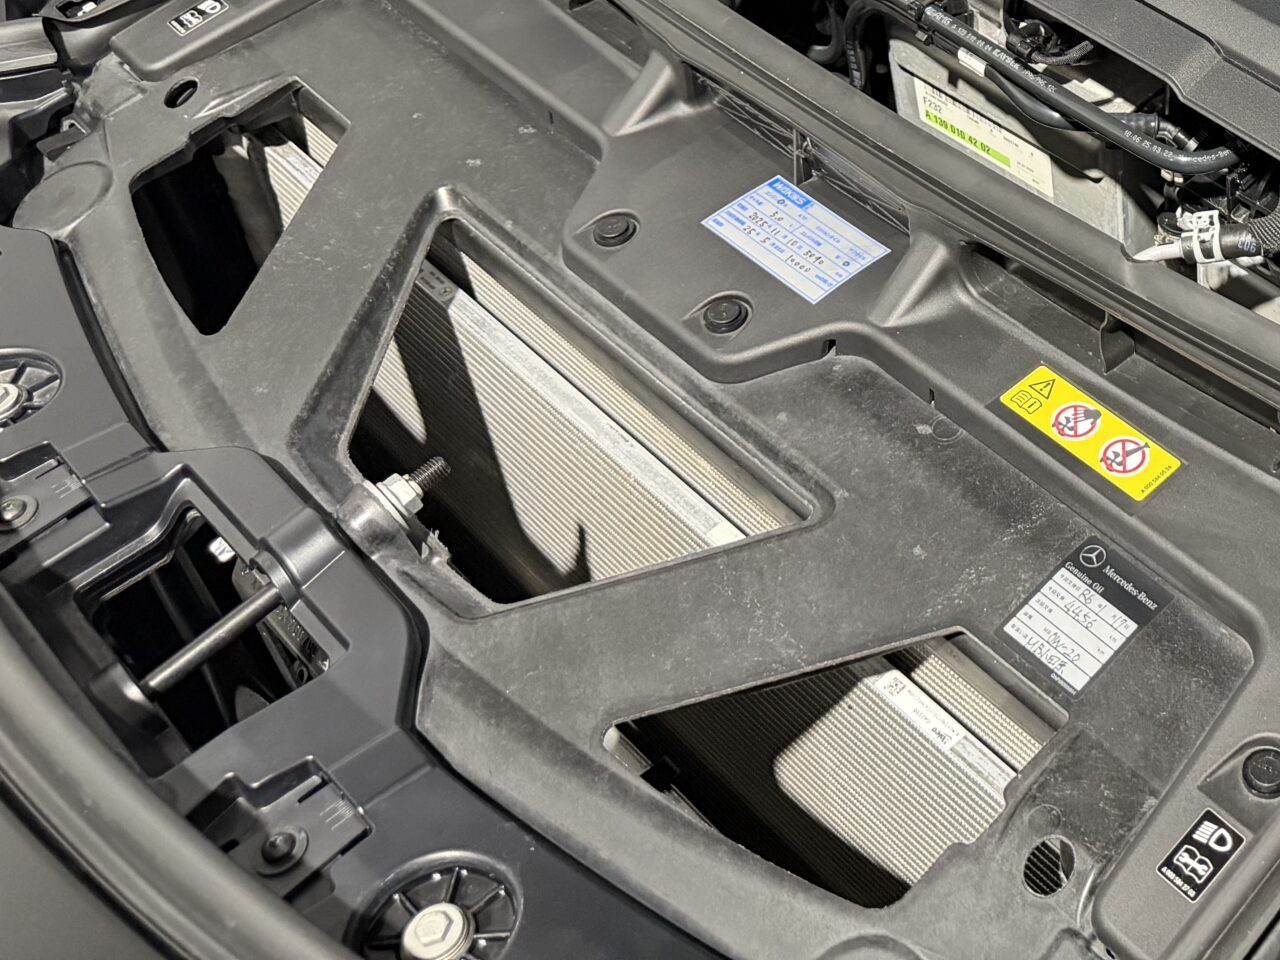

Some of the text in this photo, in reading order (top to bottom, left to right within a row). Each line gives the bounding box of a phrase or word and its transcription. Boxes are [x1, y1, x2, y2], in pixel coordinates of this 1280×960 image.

[934, 115, 948, 129] 139
[968, 136, 977, 147] 42
[980, 142, 990, 154] 02
[748, 212, 768, 227] 2025
[1065, 562, 1104, 593] Genuine Oil
[1102, 565, 1158, 610] Mercedes-Benz
